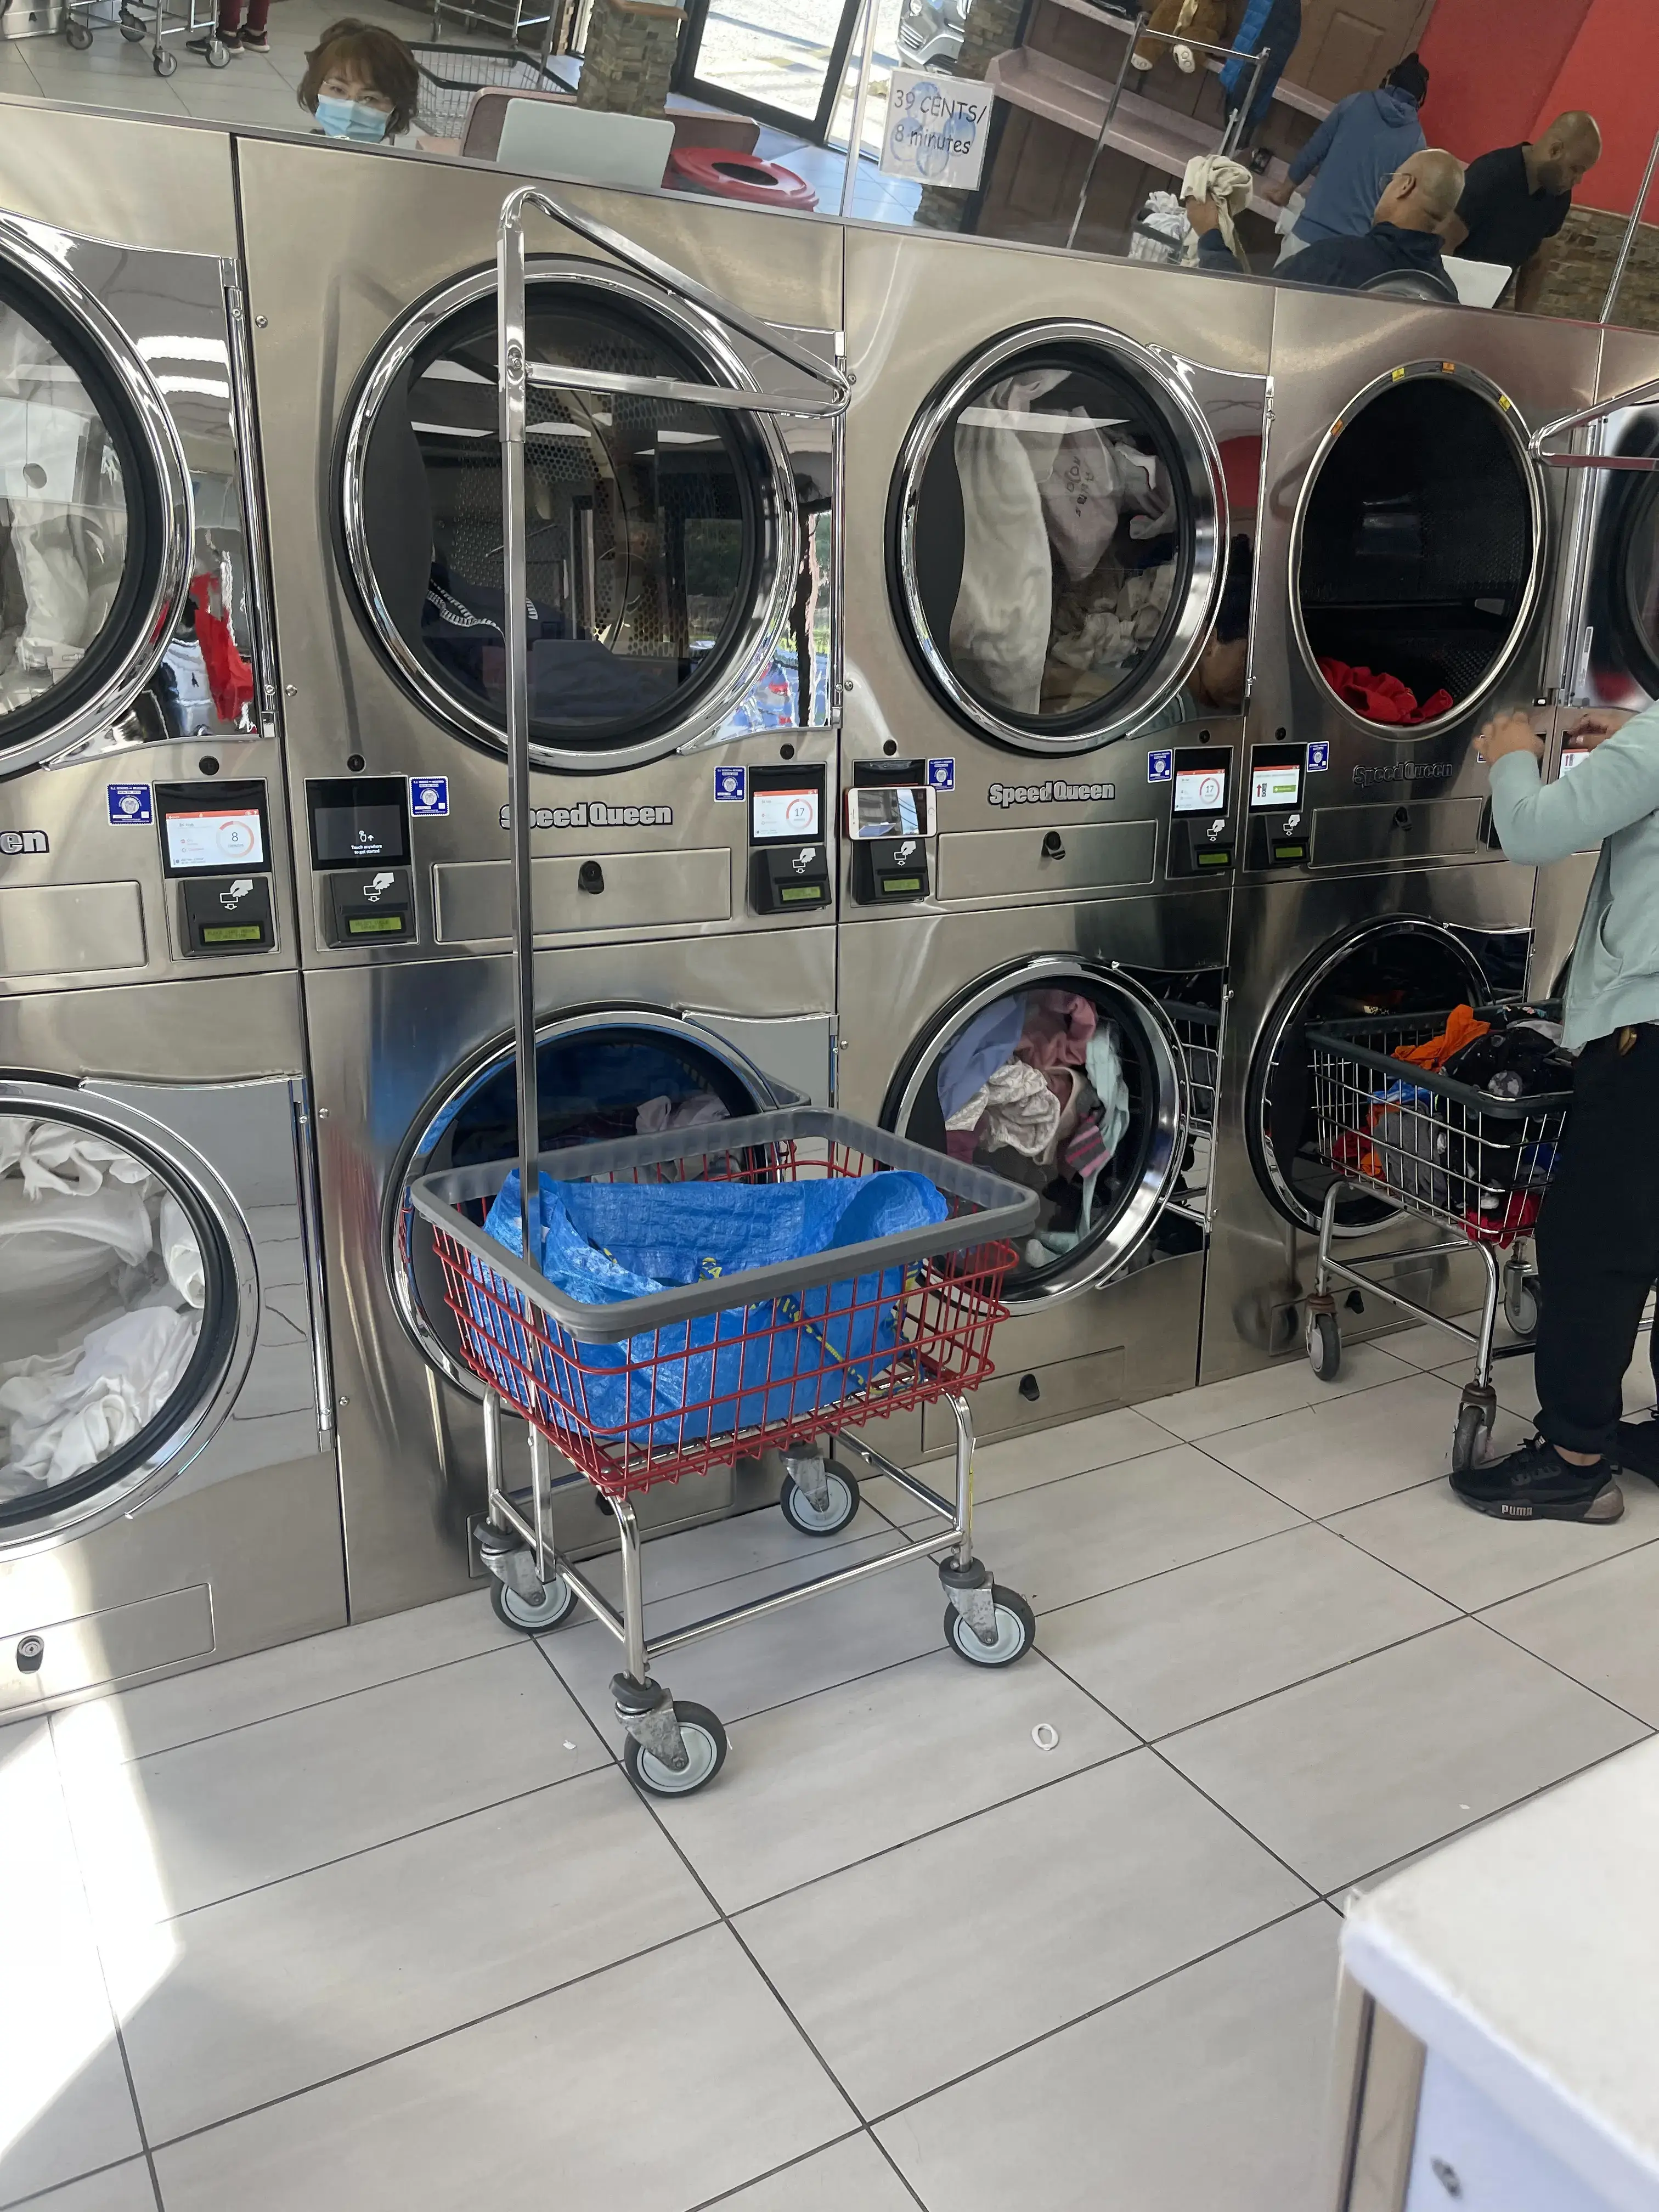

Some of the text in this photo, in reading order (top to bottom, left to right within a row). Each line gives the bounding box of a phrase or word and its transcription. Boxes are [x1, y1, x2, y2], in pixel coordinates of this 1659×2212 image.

[894, 89, 988, 124] 39 CENTS/
[895, 124, 970, 154] 8 minutes
[1352, 761, 1453, 788] Speed Queen
[989, 780, 1115, 809] Speed Queen
[588, 801, 673, 827] Queen
[795, 808, 805, 816] 17
[232, 832, 239, 842] 8
[1502, 1505, 1533, 1516] PUMA
